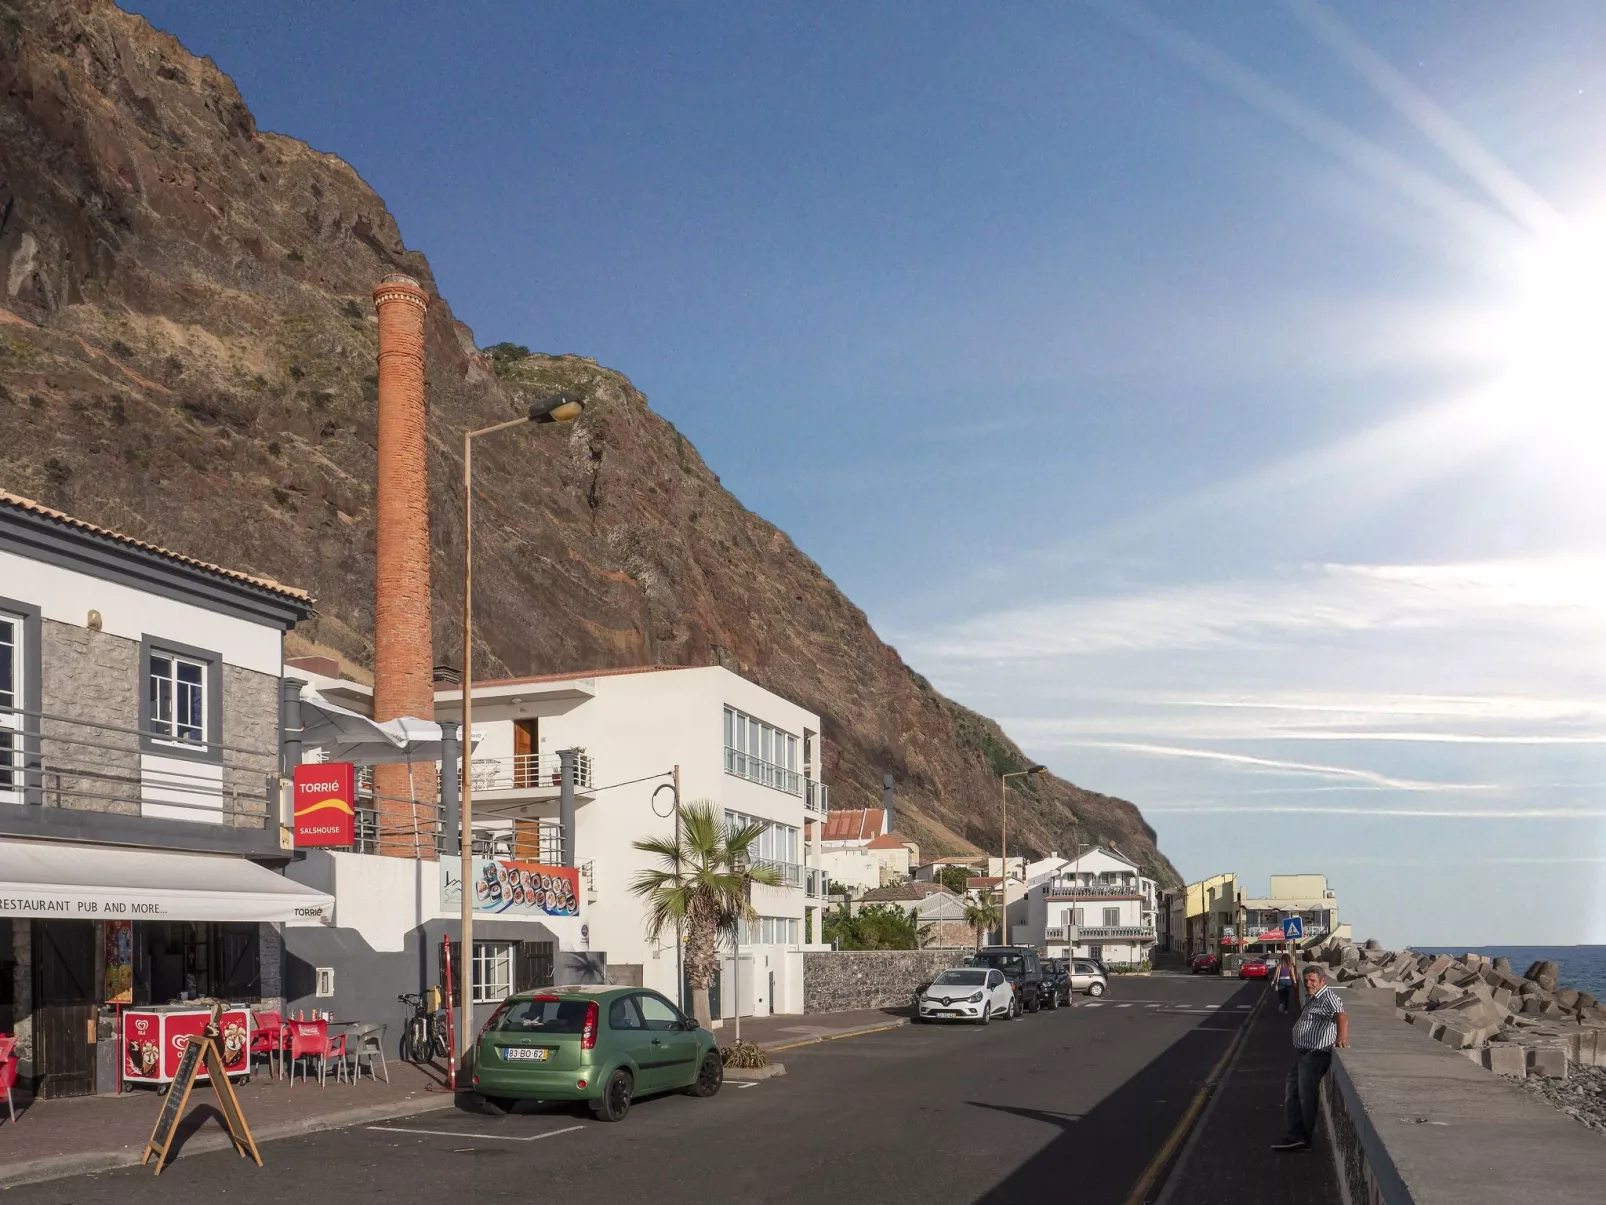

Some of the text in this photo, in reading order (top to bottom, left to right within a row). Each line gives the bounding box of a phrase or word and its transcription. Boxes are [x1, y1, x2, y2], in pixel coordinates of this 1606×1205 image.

[300, 826, 340, 835] SALSHOUSE
[77, 901, 98, 912] PUB
[103, 902, 127, 913] AND
[131, 903, 168, 914] MORE...
